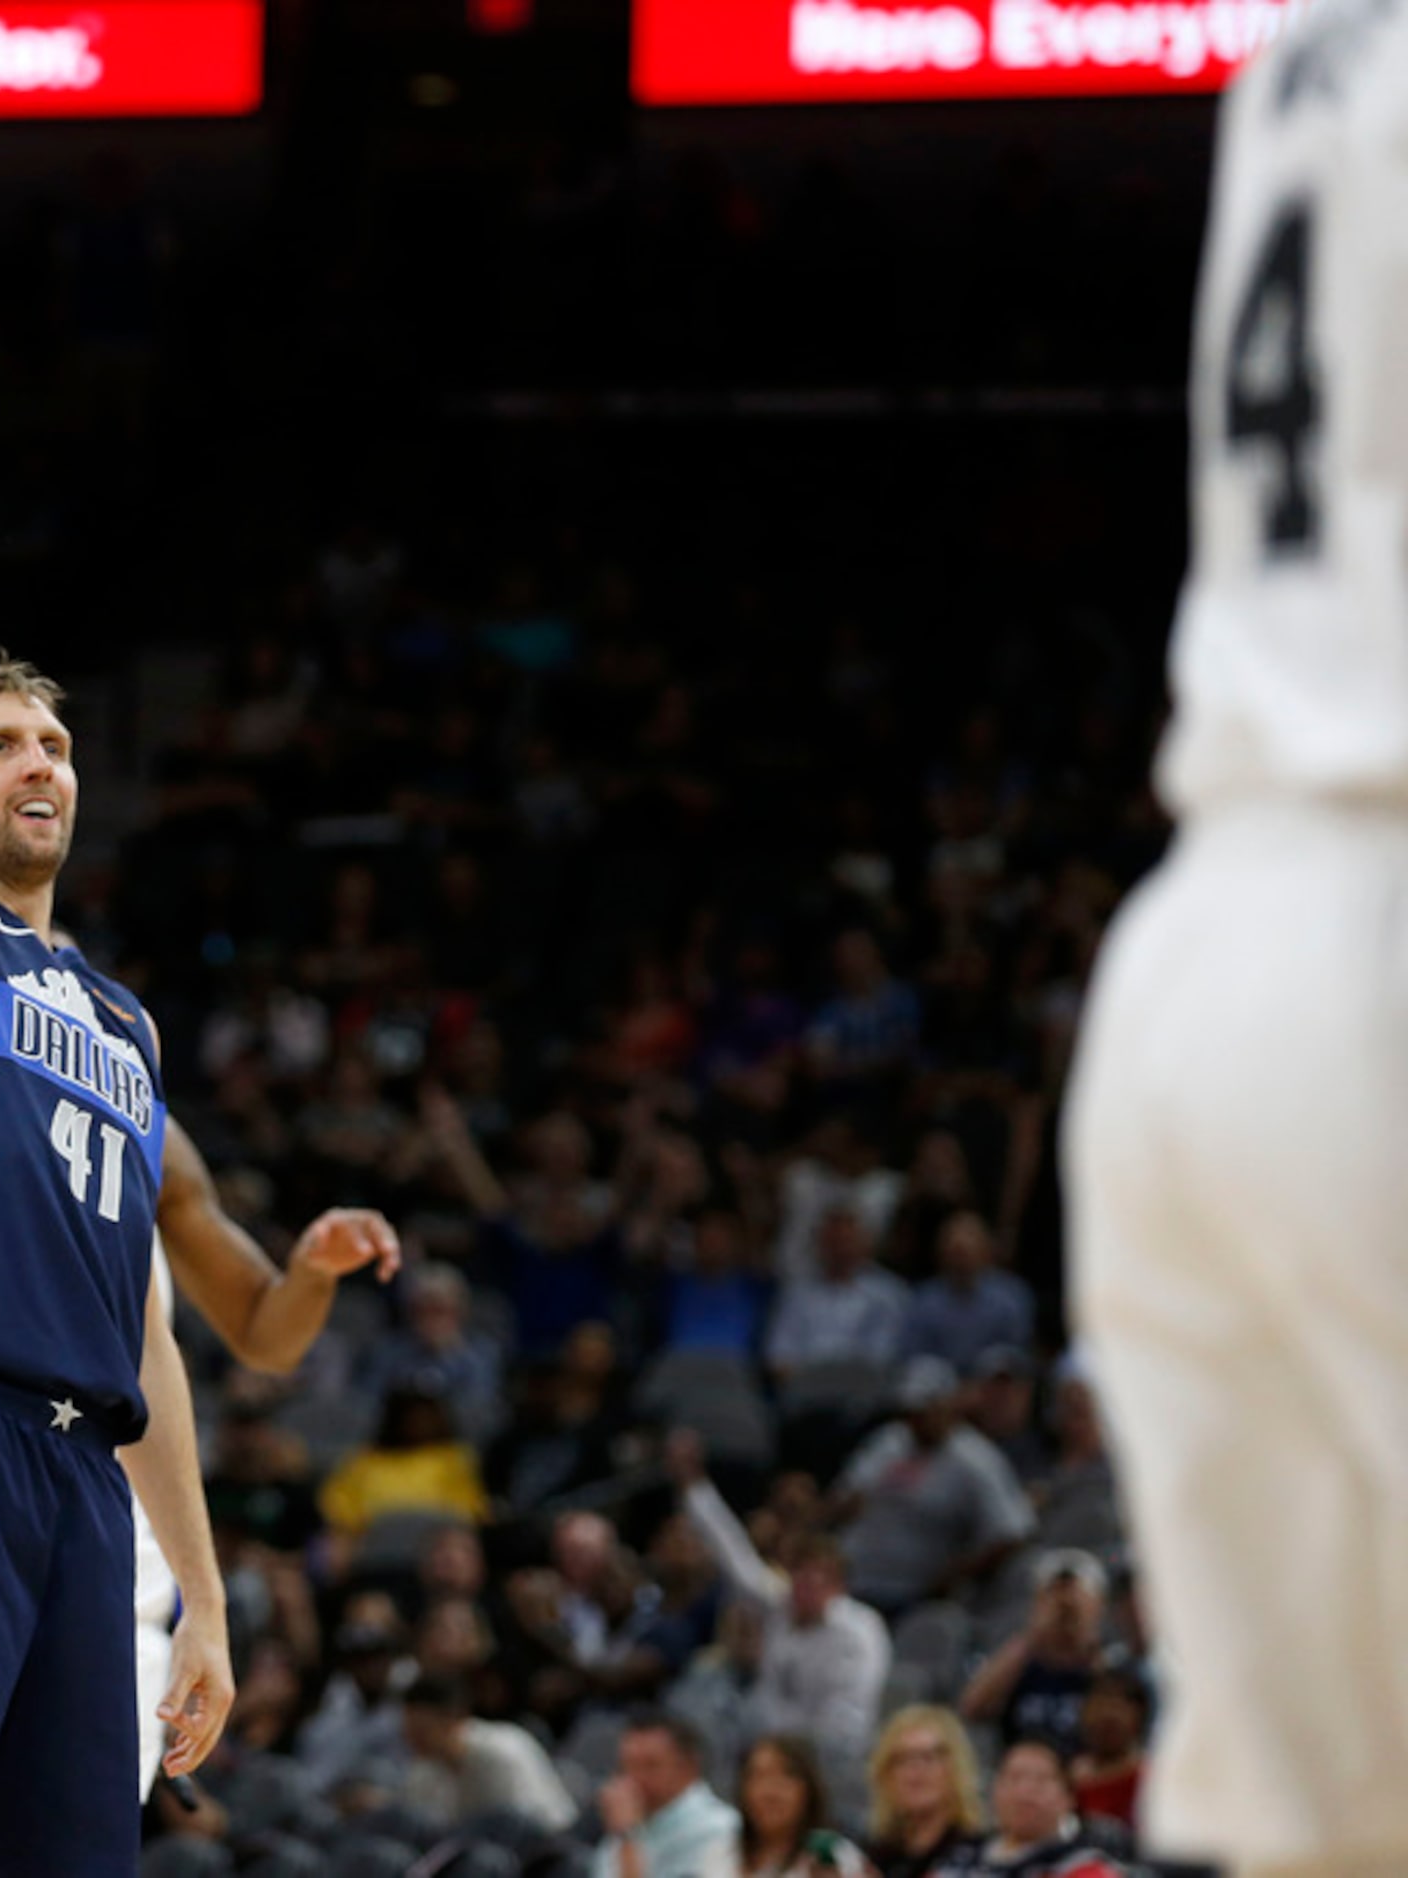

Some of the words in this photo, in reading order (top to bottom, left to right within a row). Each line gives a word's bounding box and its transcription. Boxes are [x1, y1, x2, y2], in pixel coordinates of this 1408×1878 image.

[1225, 197, 1325, 560] 4
[11, 994, 153, 1137] DALLAS
[50, 1098, 127, 1223] 41
